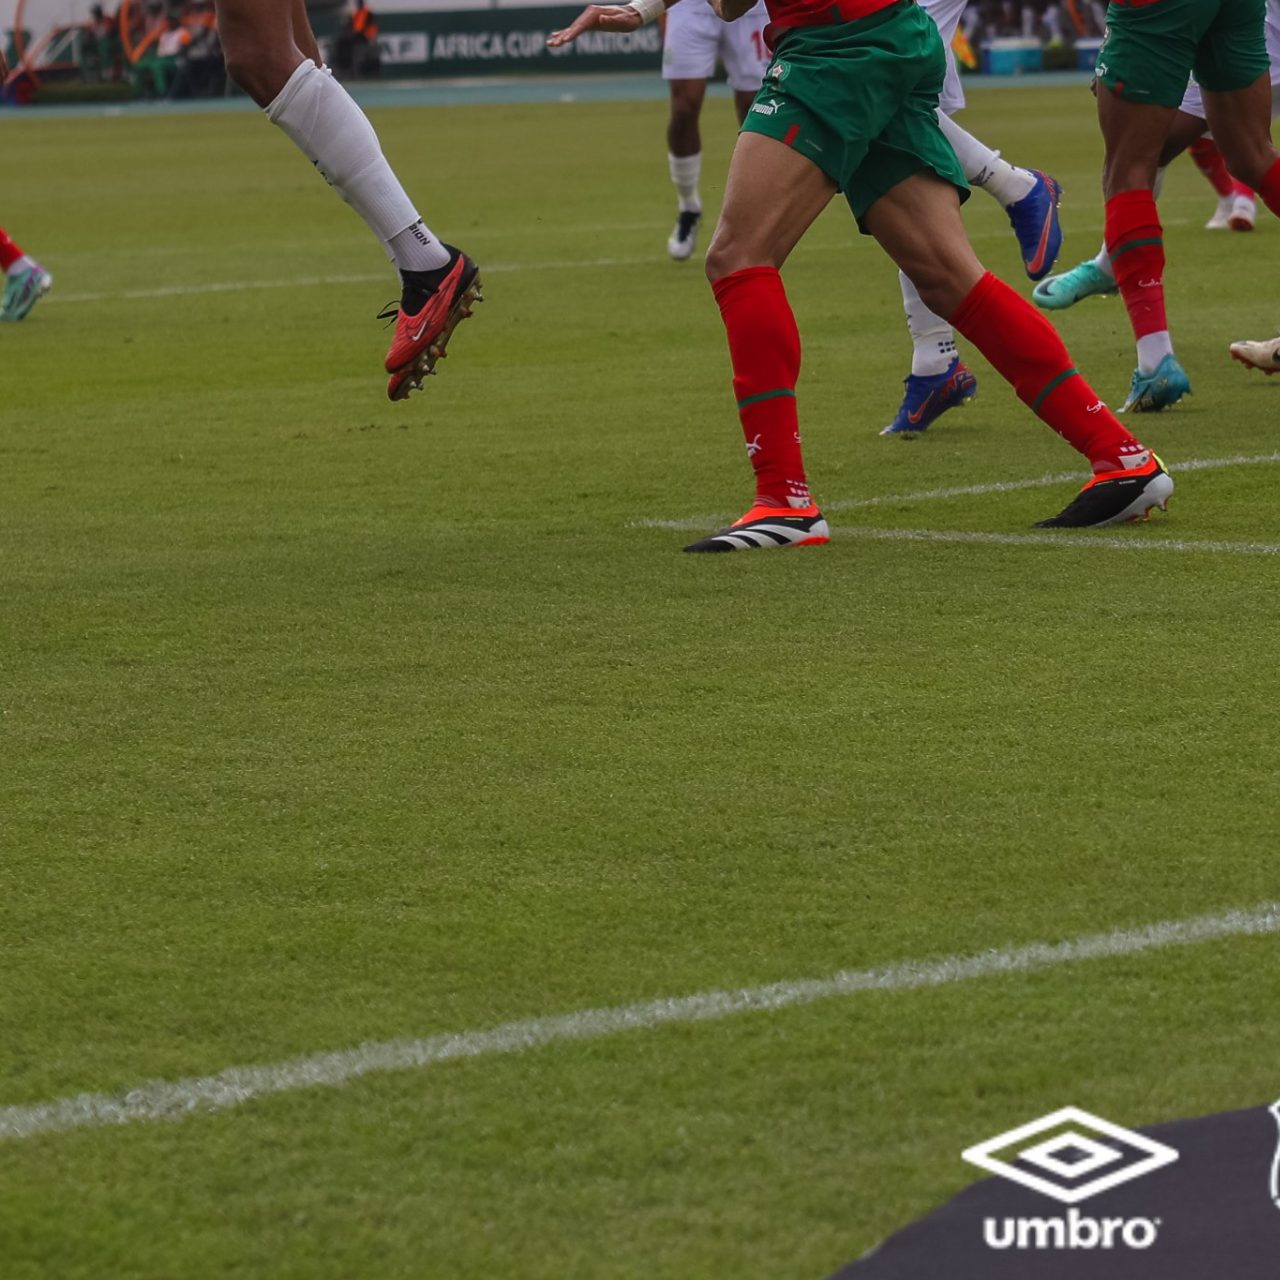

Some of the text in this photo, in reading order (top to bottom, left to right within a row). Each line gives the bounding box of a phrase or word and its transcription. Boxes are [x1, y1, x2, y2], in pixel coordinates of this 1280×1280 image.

[433, 32, 504, 59] AFRICA
[505, 31, 546, 57] CUP
[752, 103, 774, 116] PUMA
